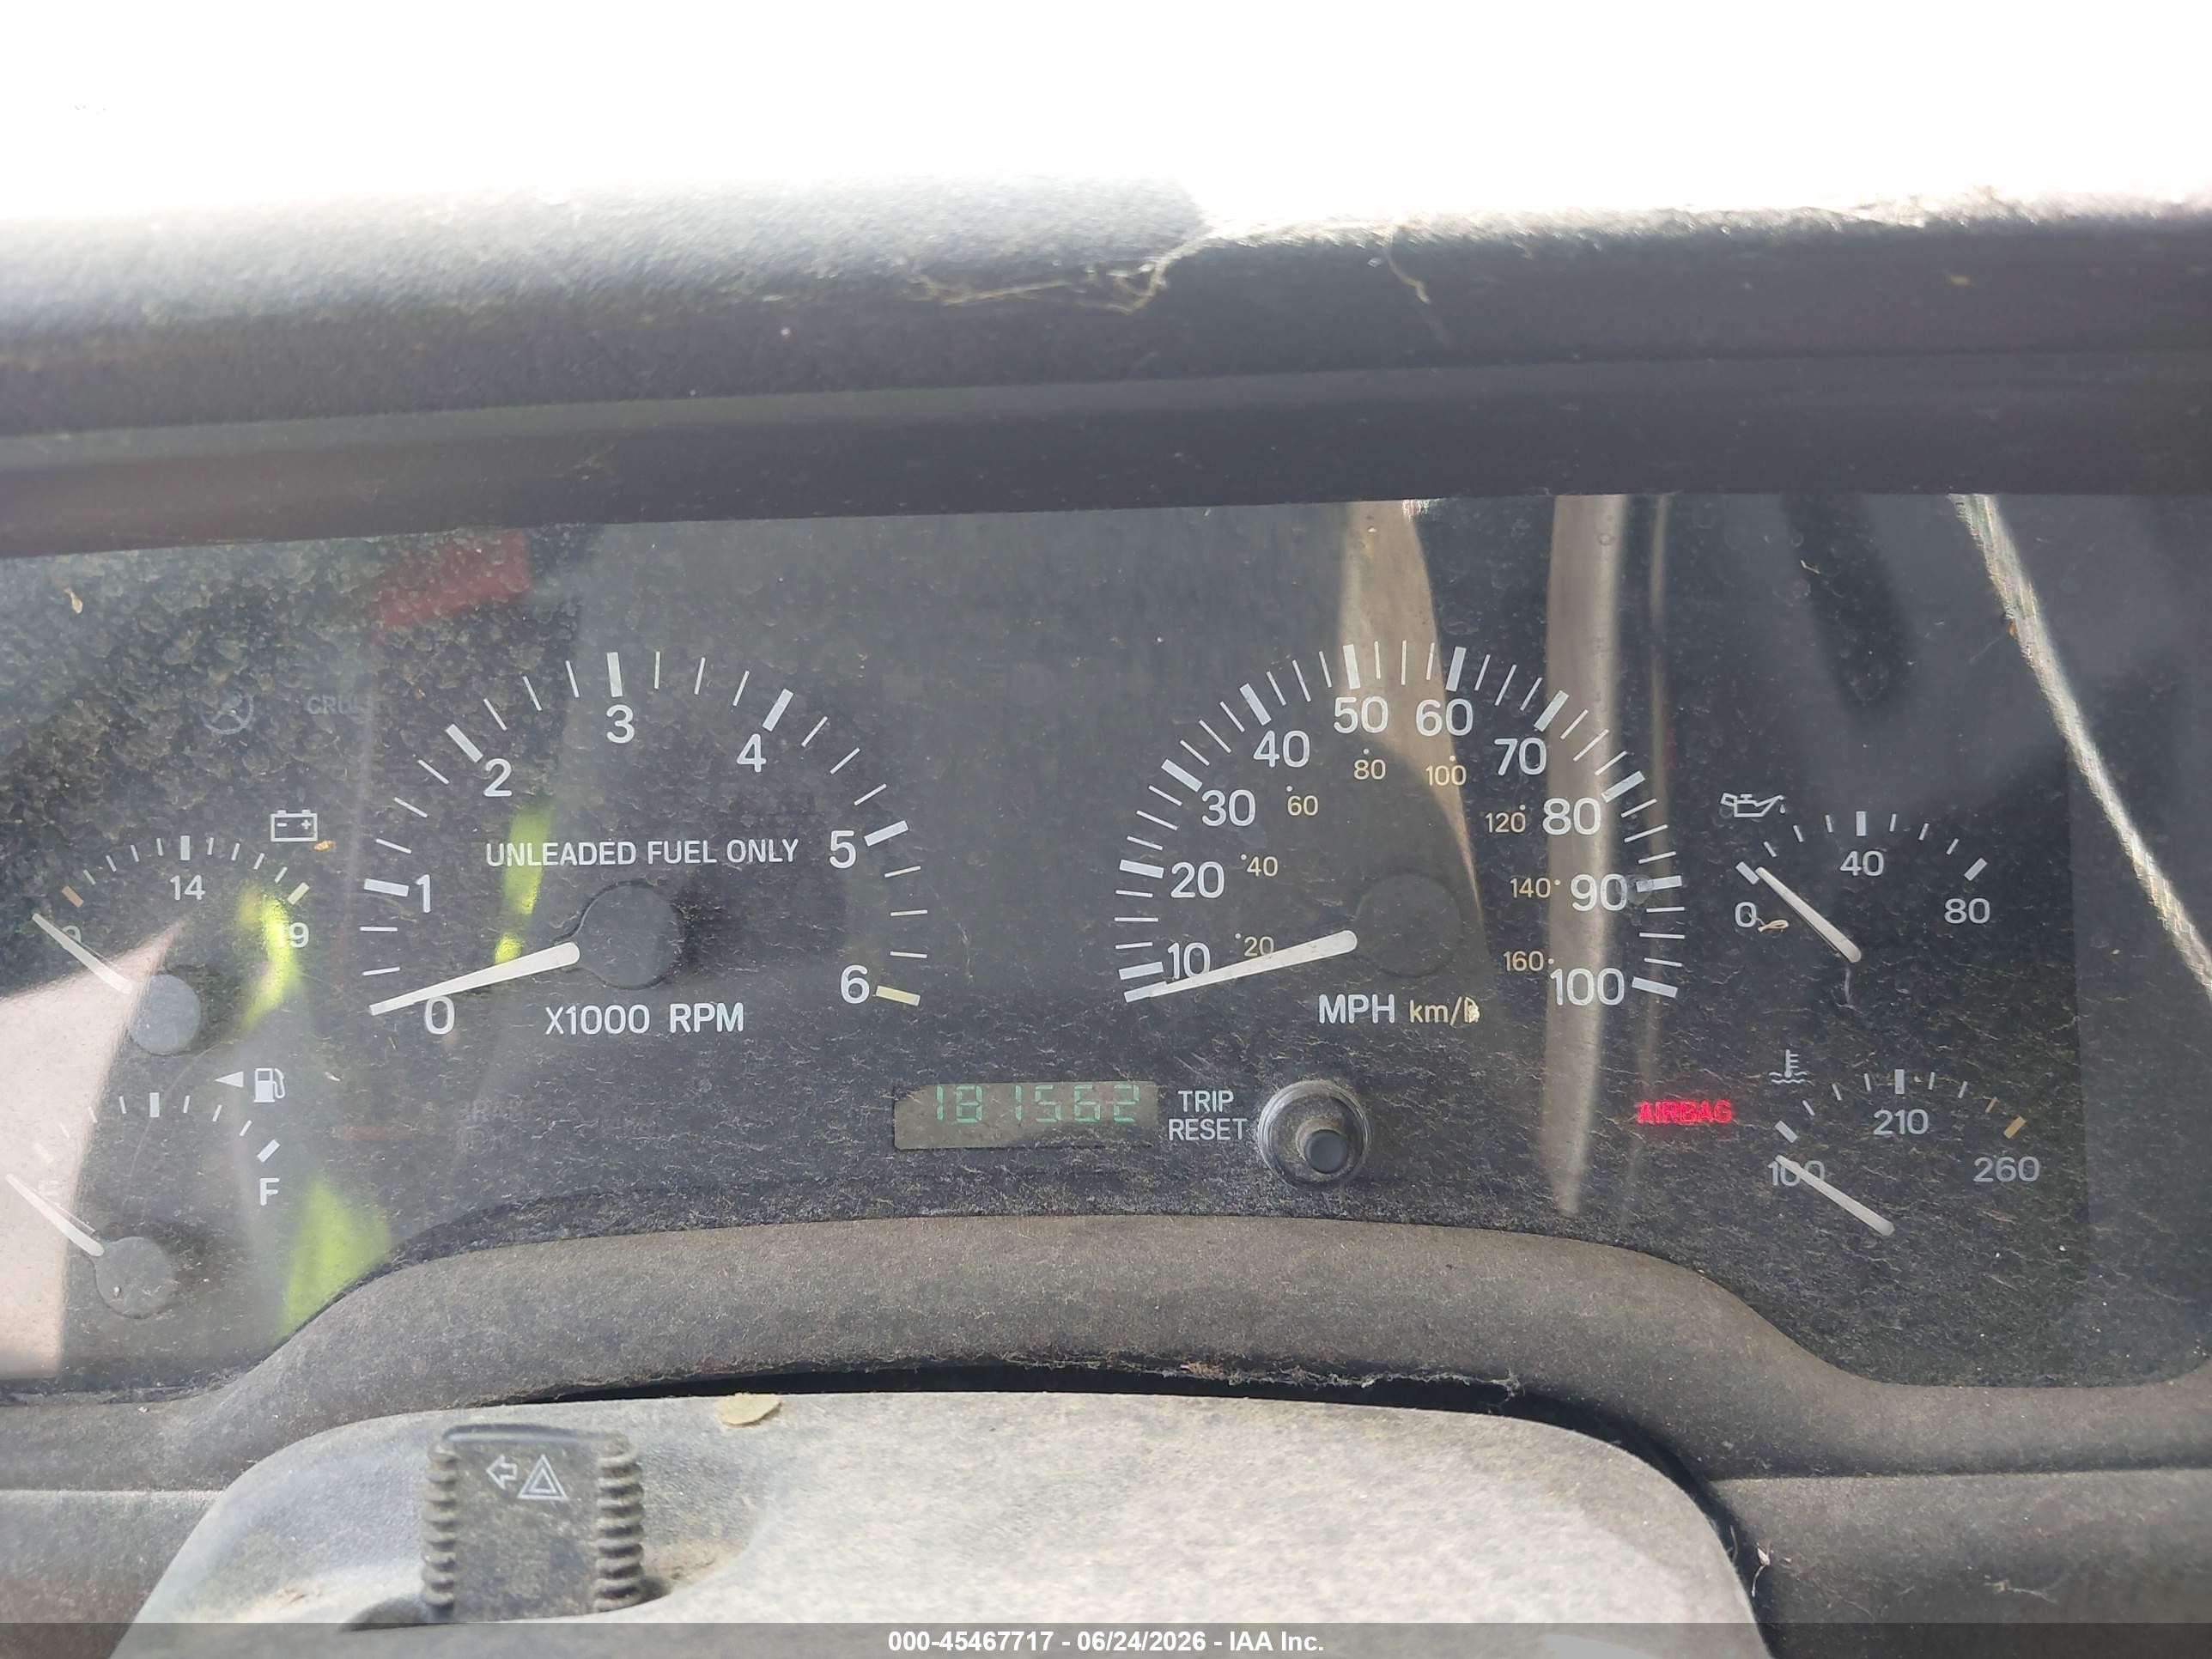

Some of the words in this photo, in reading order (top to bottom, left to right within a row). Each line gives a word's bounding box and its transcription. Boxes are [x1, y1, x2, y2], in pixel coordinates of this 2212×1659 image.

[605, 704, 635, 744] 3
[1334, 696, 1389, 734] 50
[1416, 698, 1474, 737] 60
[737, 733, 766, 772] 4
[1253, 730, 1311, 769] 40
[1494, 738, 1547, 776] 70
[483, 759, 513, 797] 2
[1353, 759, 1386, 781] 80
[1425, 765, 1467, 787] 100
[1201, 788, 1256, 827] 30
[1287, 795, 1319, 817] 60
[1543, 798, 1601, 836] 80
[1486, 812, 1527, 834] 120
[486, 841, 636, 867] UNLEADED
[647, 840, 717, 864] FUEL
[727, 838, 799, 863] ONLY
[829, 830, 856, 868] 5
[1247, 856, 1278, 878] 40
[1840, 851, 1884, 877] 40
[171, 875, 205, 901] 14
[416, 874, 432, 913] 1
[1170, 861, 1225, 899] 20
[1510, 878, 1552, 899] 140
[1571, 873, 1628, 911] 90
[1735, 901, 1757, 927] 0
[1945, 897, 1990, 925] 80
[1167, 942, 1211, 980] 10
[1244, 936, 1274, 957] 20
[1504, 951, 1545, 972] 160
[840, 964, 870, 1004] 6
[1549, 967, 1625, 1006] 100
[425, 996, 455, 1034] 0
[545, 1005, 650, 1035] X1000
[669, 1002, 744, 1032] RPM
[1319, 994, 1395, 1024] MPH
[935, 1084, 1140, 1124] 181562
[1178, 1090, 1234, 1113] TRIP
[1637, 1100, 1732, 1124] AIRBAG
[1169, 1118, 1247, 1140] RESET
[1874, 1109, 1929, 1135] 210
[1767, 1160, 1826, 1187] 100
[1973, 1156, 2039, 1183] 260
[260, 1177, 280, 1206] F
